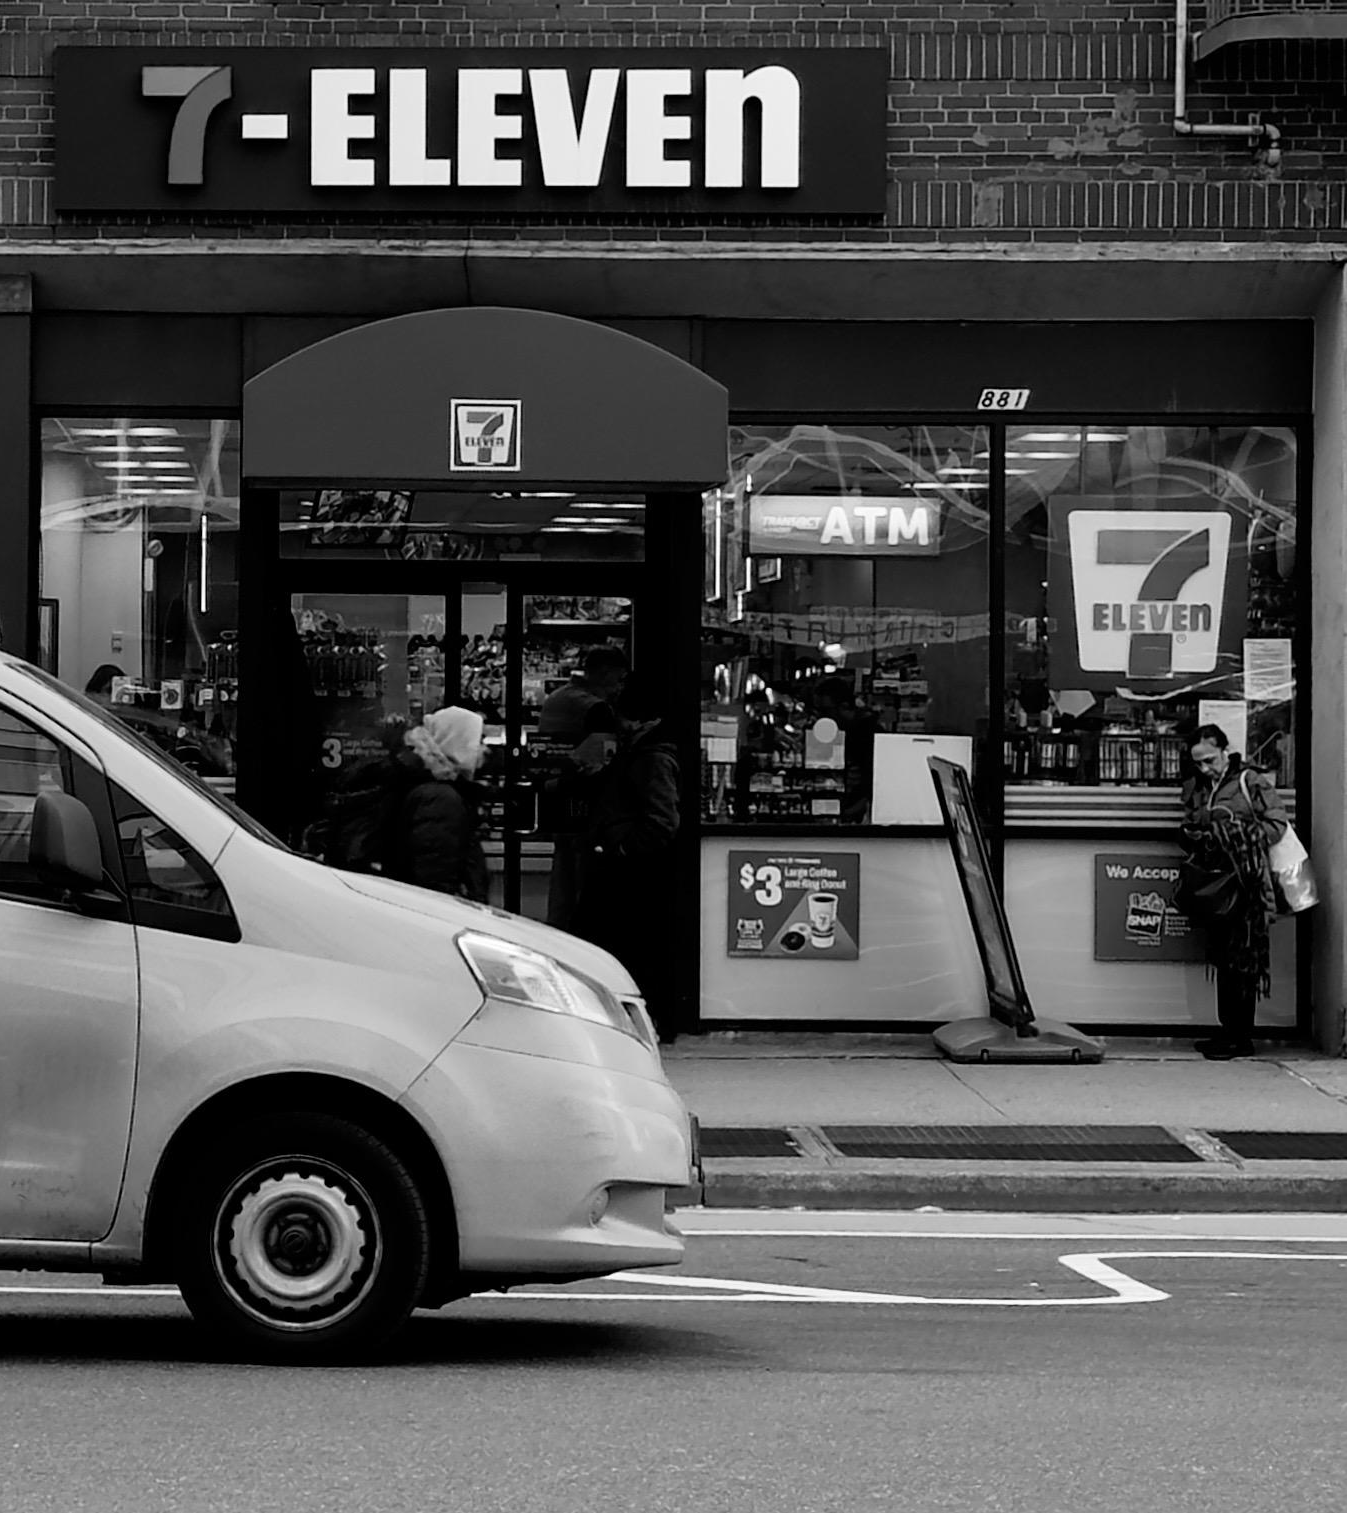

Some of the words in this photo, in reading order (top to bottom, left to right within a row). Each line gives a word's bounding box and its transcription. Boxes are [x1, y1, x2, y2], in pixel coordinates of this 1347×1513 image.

[981, 391, 1023, 408] 881
[819, 505, 931, 547] ATM
[1097, 528, 1210, 677] 7
[739, 862, 783, 907] $3
[1105, 864, 1129, 879] We
[1132, 864, 1181, 882] Accep
[1127, 914, 1162, 927] SNAP
